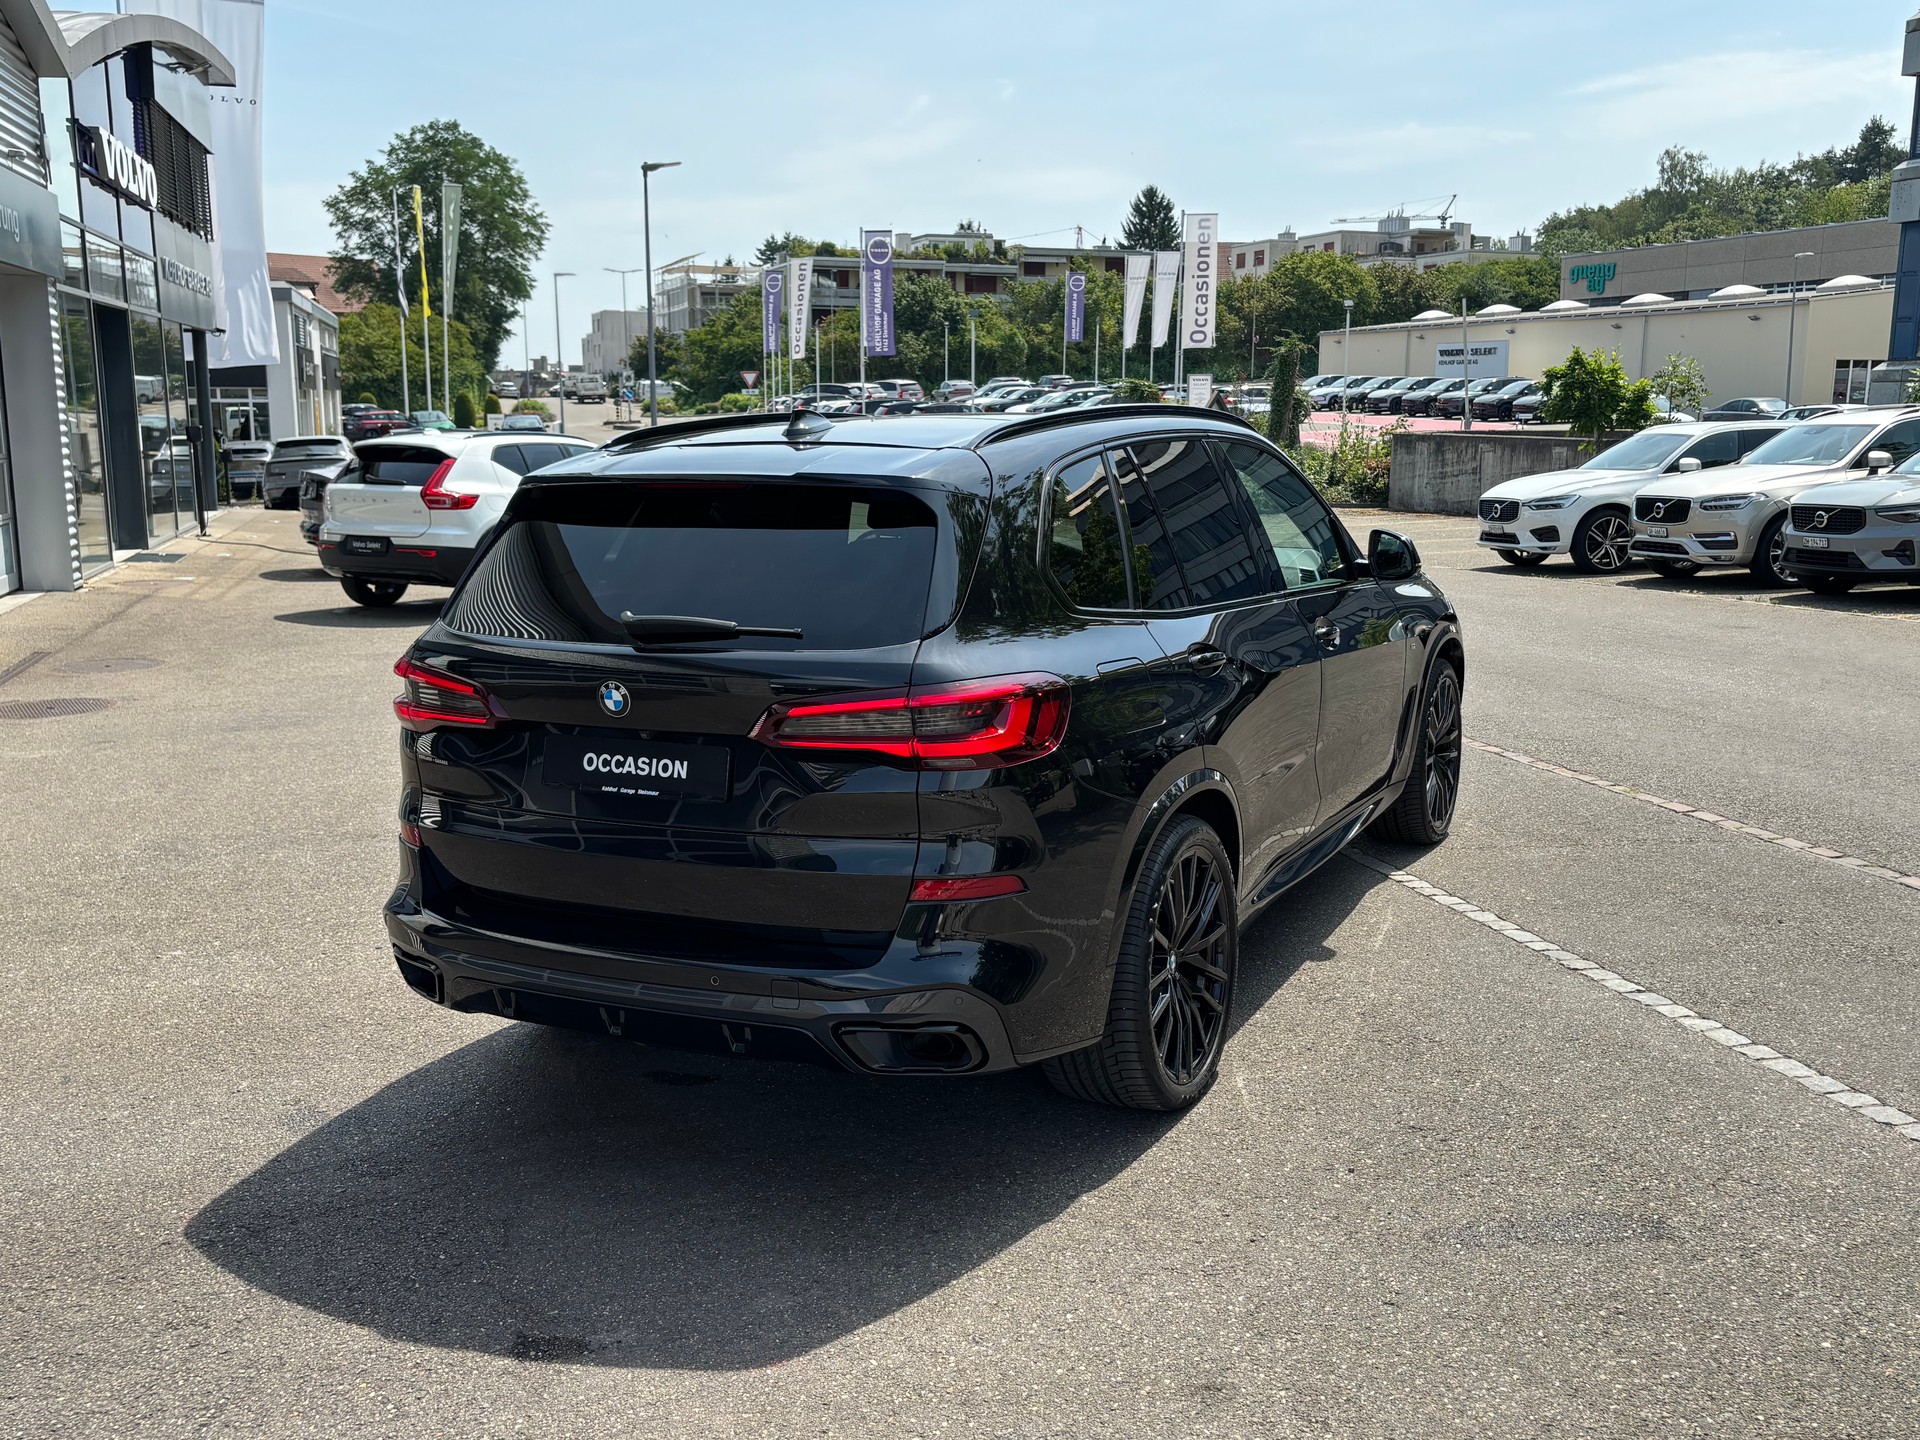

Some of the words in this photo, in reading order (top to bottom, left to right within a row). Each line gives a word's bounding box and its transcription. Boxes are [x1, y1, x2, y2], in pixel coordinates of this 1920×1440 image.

[99, 127, 158, 208] VOLVO
[873, 268, 882, 279] AG
[1190, 217, 1211, 344] Occasionen
[1569, 263, 1616, 284] gueng
[874, 281, 882, 314] GARAGE
[1587, 278, 1605, 295] ag
[794, 262, 808, 355] Occasionen
[874, 315, 882, 352] KEHLHOF
[1470, 347, 1498, 356] SELEKT
[352, 540, 366, 548] Volvo
[366, 541, 381, 549] Selekt
[583, 752, 688, 779] OCCASION
[620, 787, 636, 795] Garage
